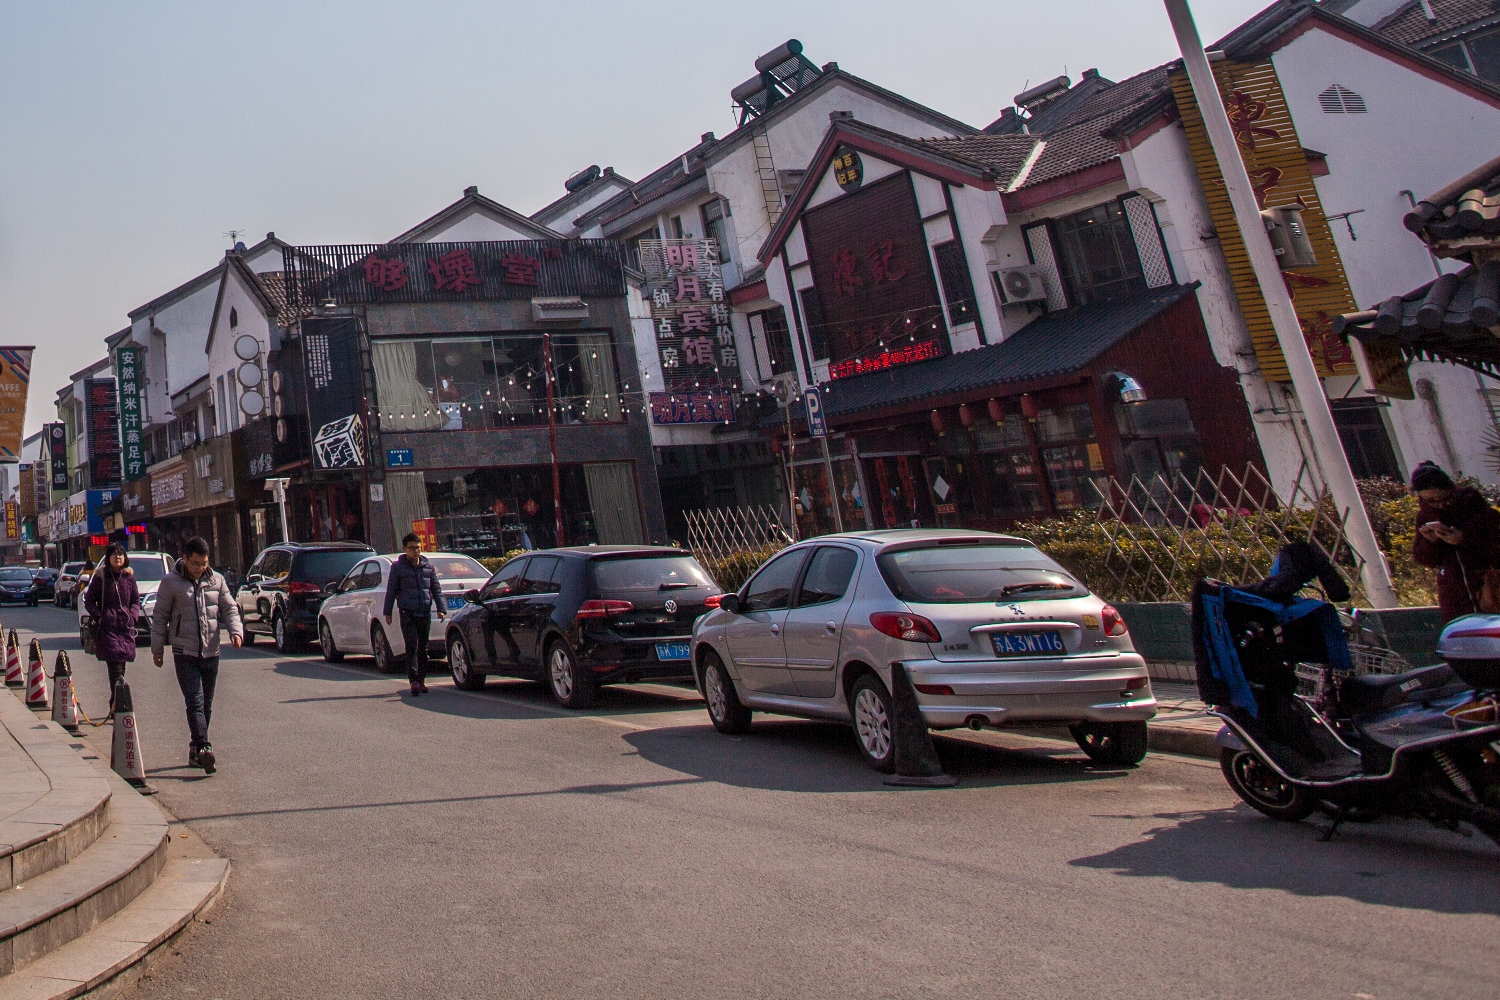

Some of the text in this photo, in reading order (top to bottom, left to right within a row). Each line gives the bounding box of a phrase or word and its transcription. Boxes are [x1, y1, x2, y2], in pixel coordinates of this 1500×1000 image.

[652, 288, 680, 368] 钟点房
[666, 244, 716, 366] 明月宾馆
[699, 239, 739, 368] 天天有特价房
[121, 350, 142, 476] 安然纳米汗蒸足疗
[651, 393, 734, 424] 明月宾馆
[806, 393, 819, 425] P
[124, 731, 135, 771] 请勿泊车
